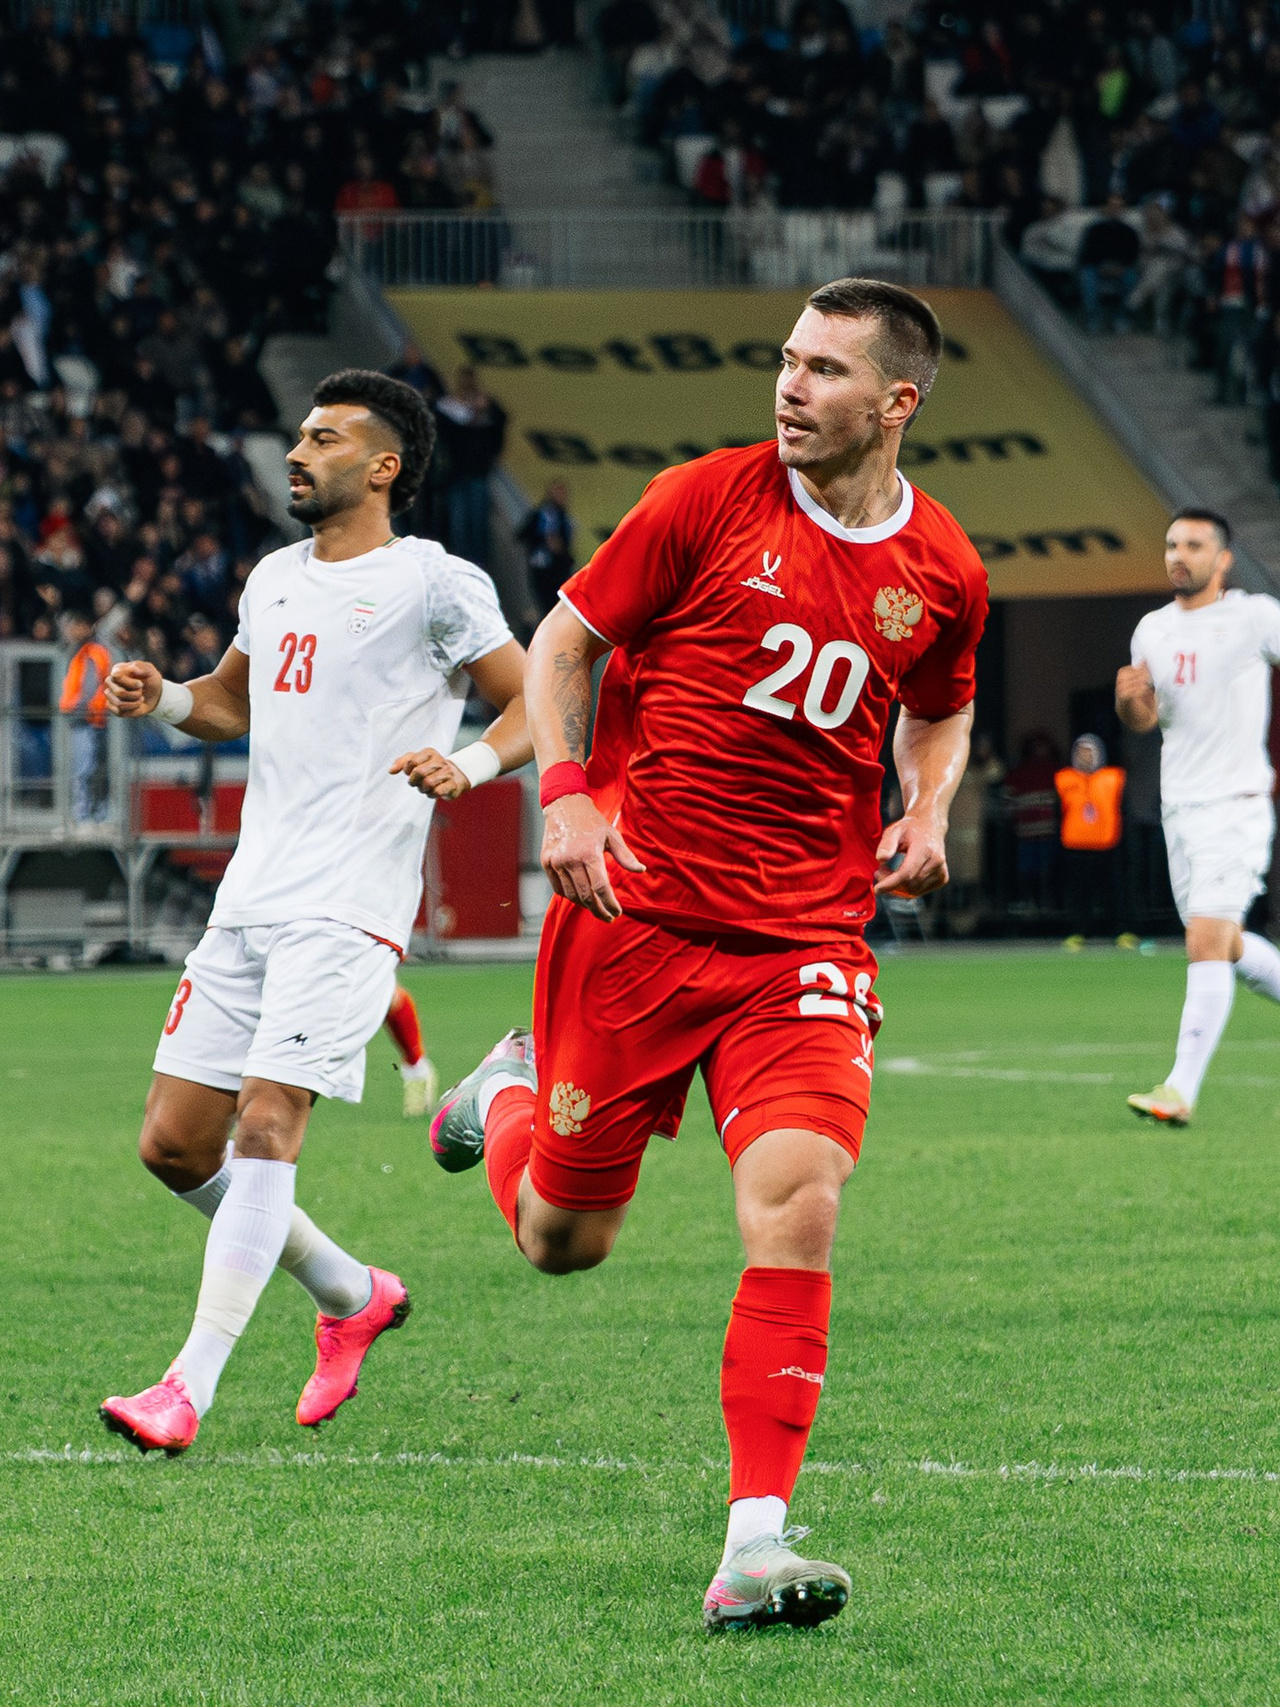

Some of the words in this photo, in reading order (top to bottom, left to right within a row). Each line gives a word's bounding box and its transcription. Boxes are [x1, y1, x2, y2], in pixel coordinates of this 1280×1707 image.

[272, 631, 317, 694] 23
[742, 622, 870, 730] 20
[1173, 650, 1197, 686] 21
